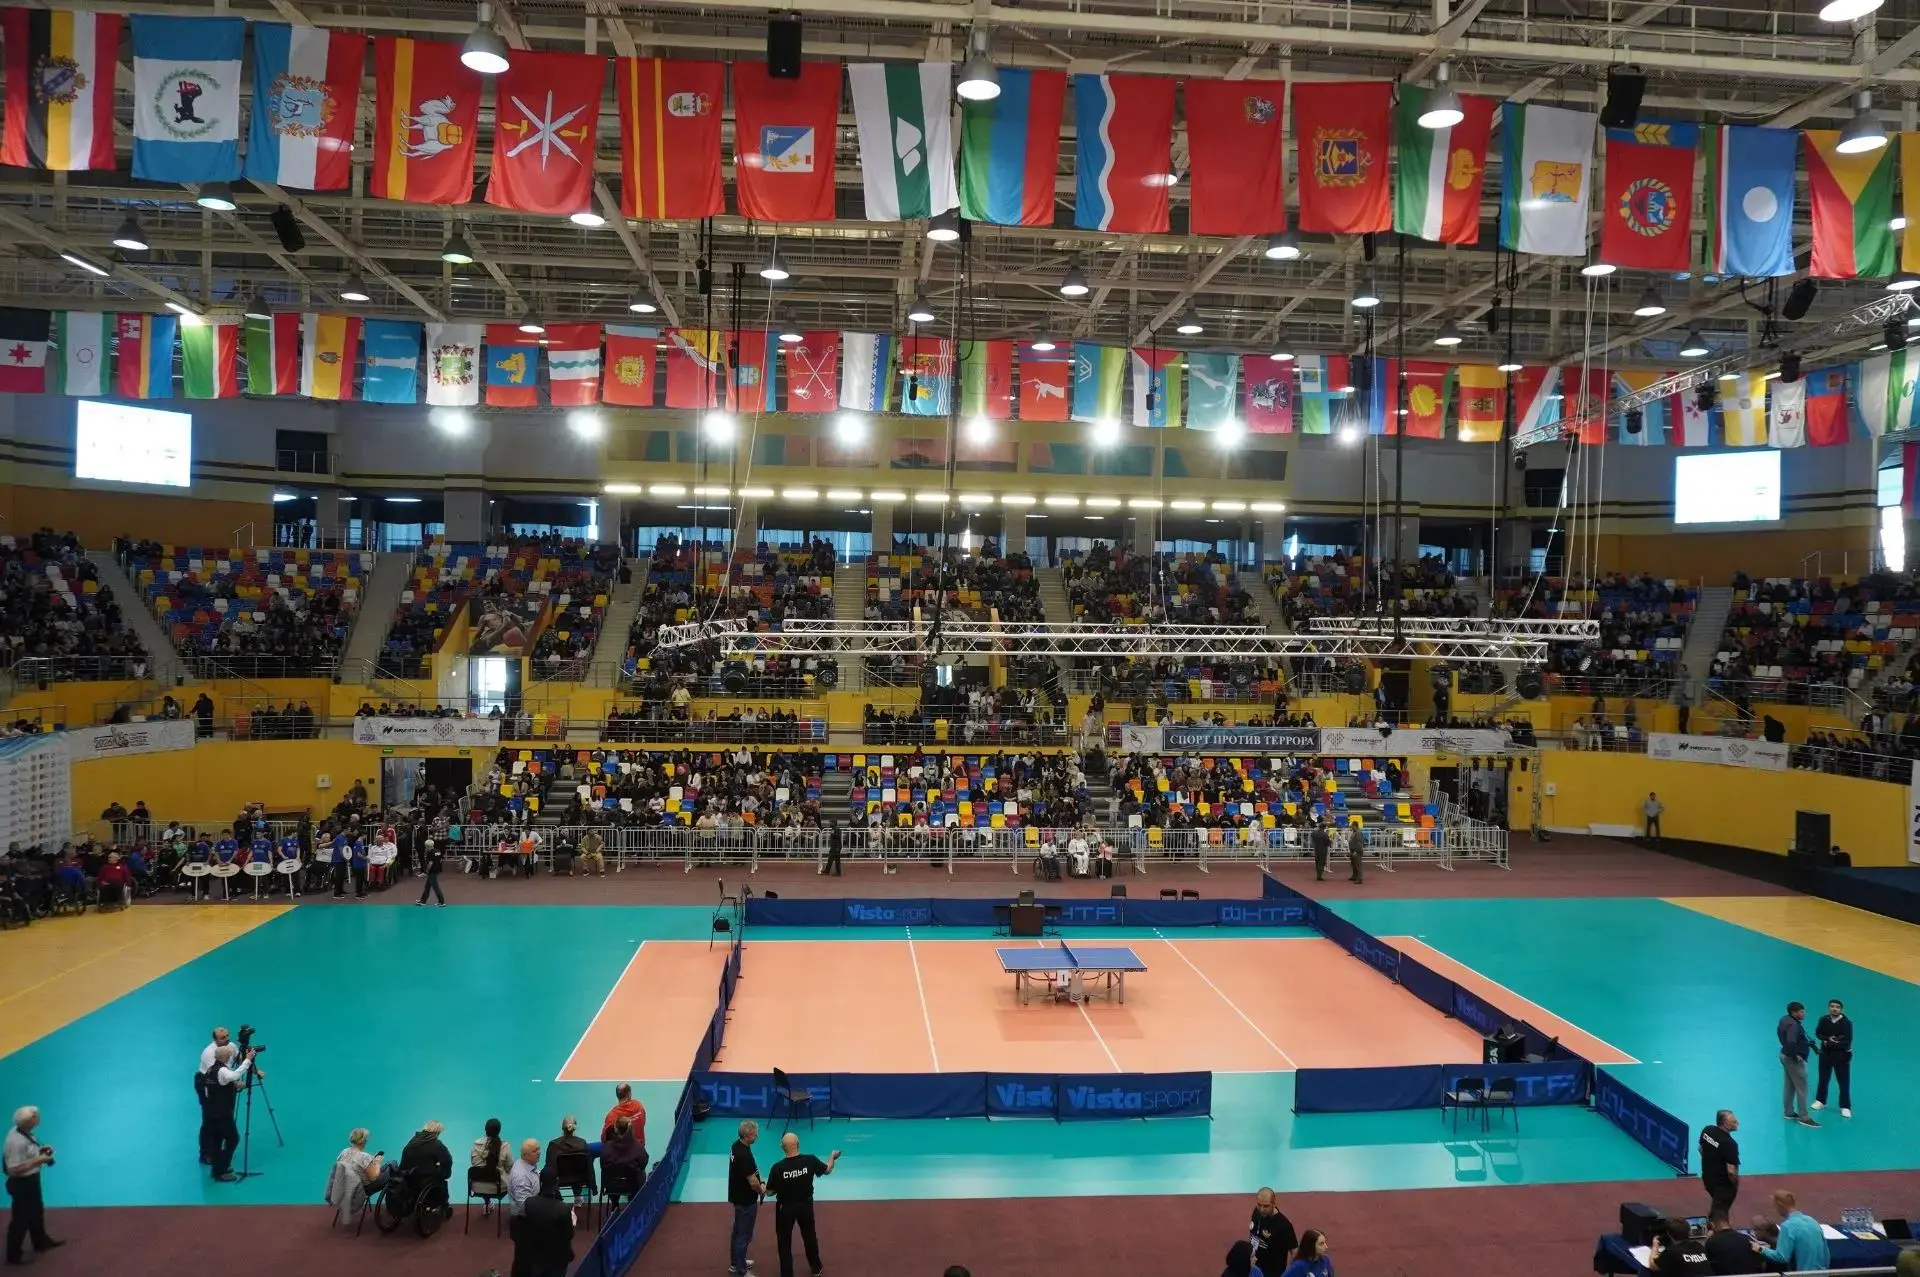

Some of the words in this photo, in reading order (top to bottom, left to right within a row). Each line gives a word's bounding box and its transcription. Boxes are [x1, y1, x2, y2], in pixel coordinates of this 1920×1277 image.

[1170, 735, 1209, 745] СПОРТ
[1213, 735, 1261, 745] ПРОТИВ
[1264, 736, 1315, 746] ТЕРРОРА
[783, 1167, 808, 1179] СУДЬЯ
